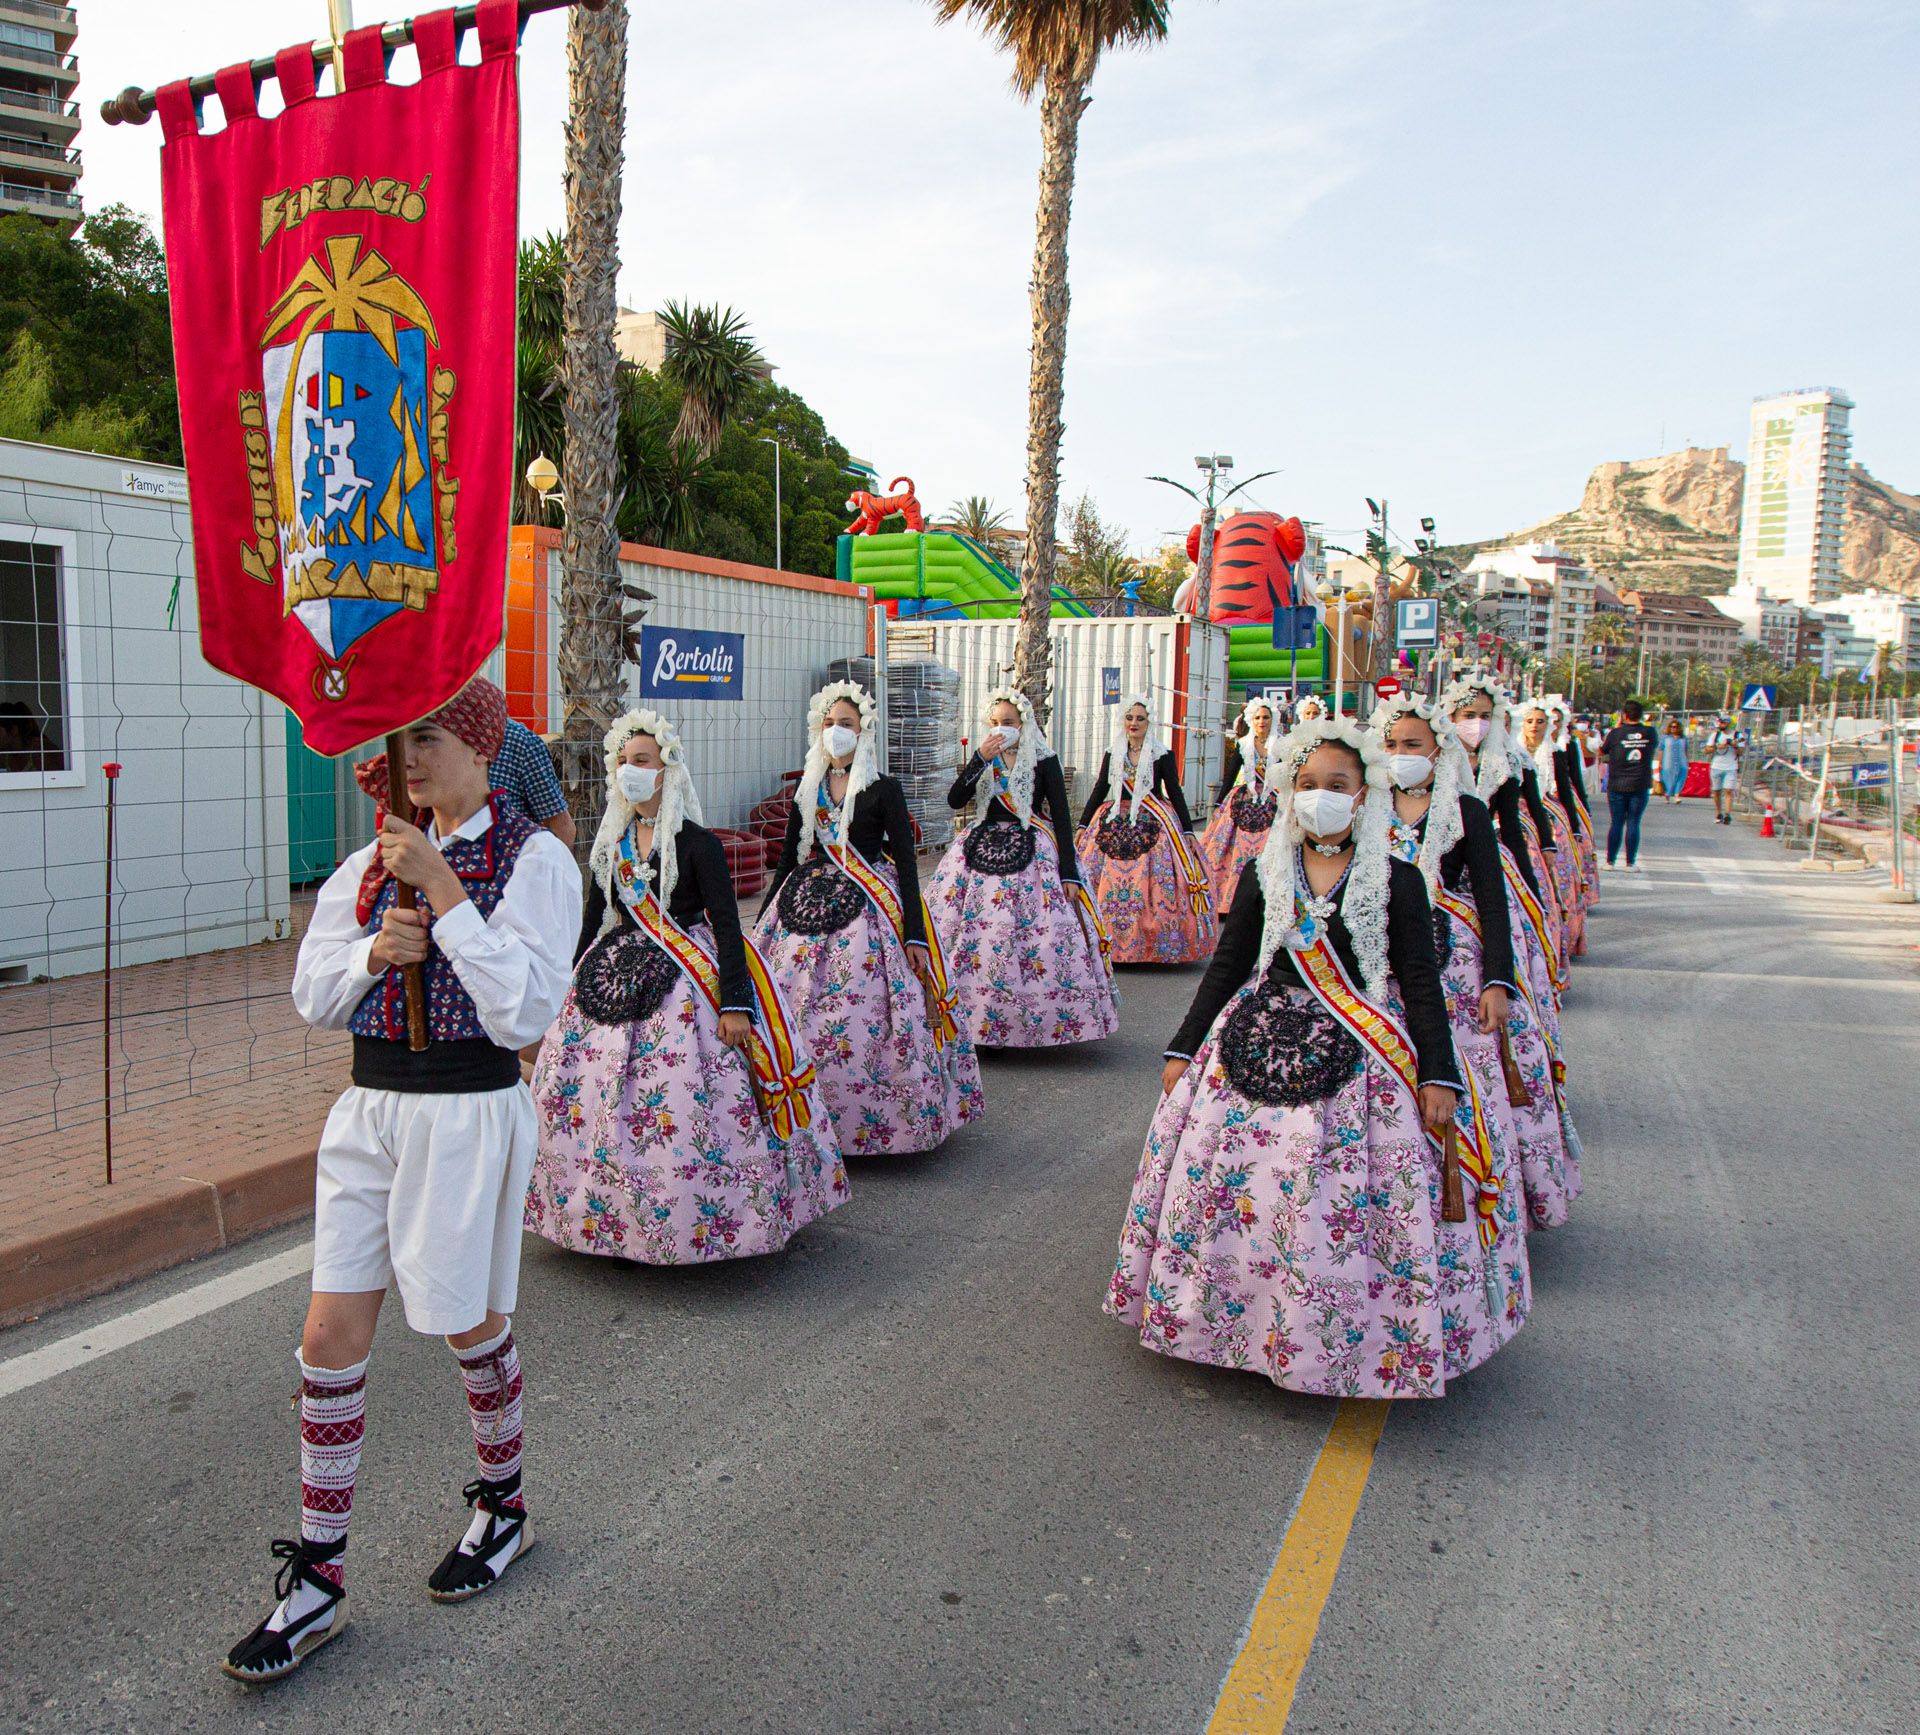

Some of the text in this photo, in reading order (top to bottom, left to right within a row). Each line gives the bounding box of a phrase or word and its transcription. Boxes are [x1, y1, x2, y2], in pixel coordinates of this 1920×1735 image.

[260, 173, 432, 253] FEDERACIÓ
[1405, 603, 1429, 628] P
[652, 638, 733, 687] Bertolín
